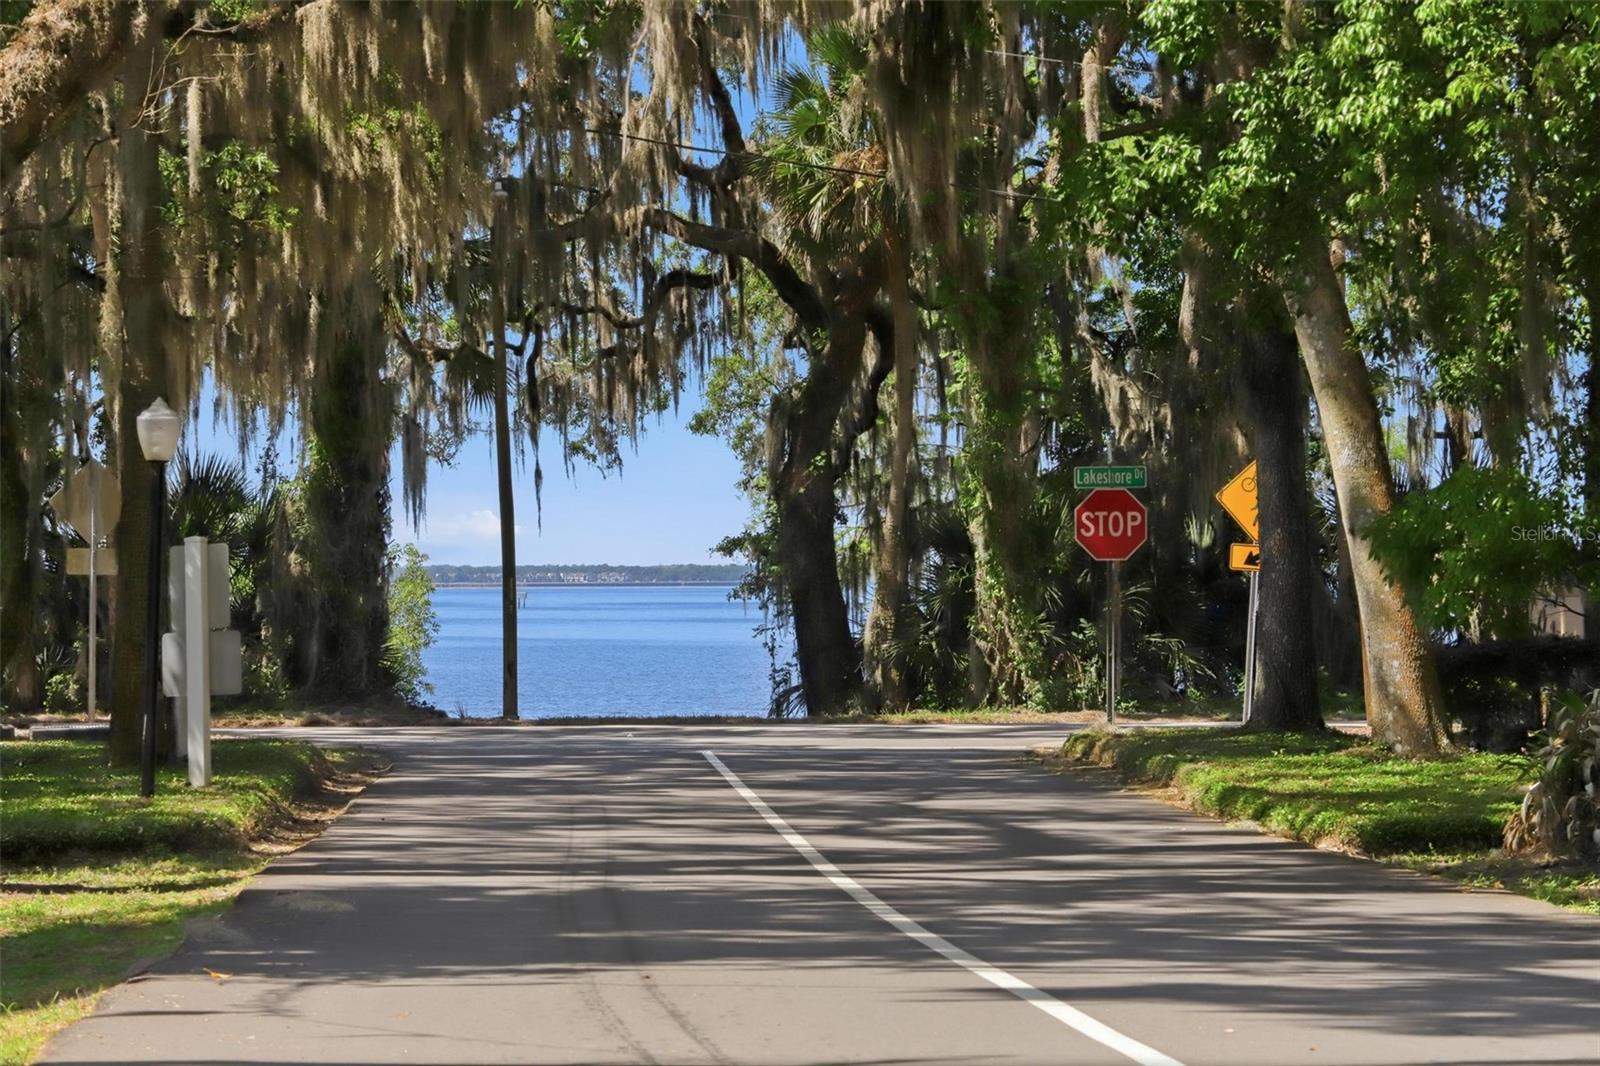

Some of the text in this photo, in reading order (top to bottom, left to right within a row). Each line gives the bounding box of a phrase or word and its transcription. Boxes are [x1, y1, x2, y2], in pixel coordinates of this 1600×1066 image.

[1076, 469, 1144, 485] Lakeshore Dr
[1080, 511, 1142, 537] STOP
